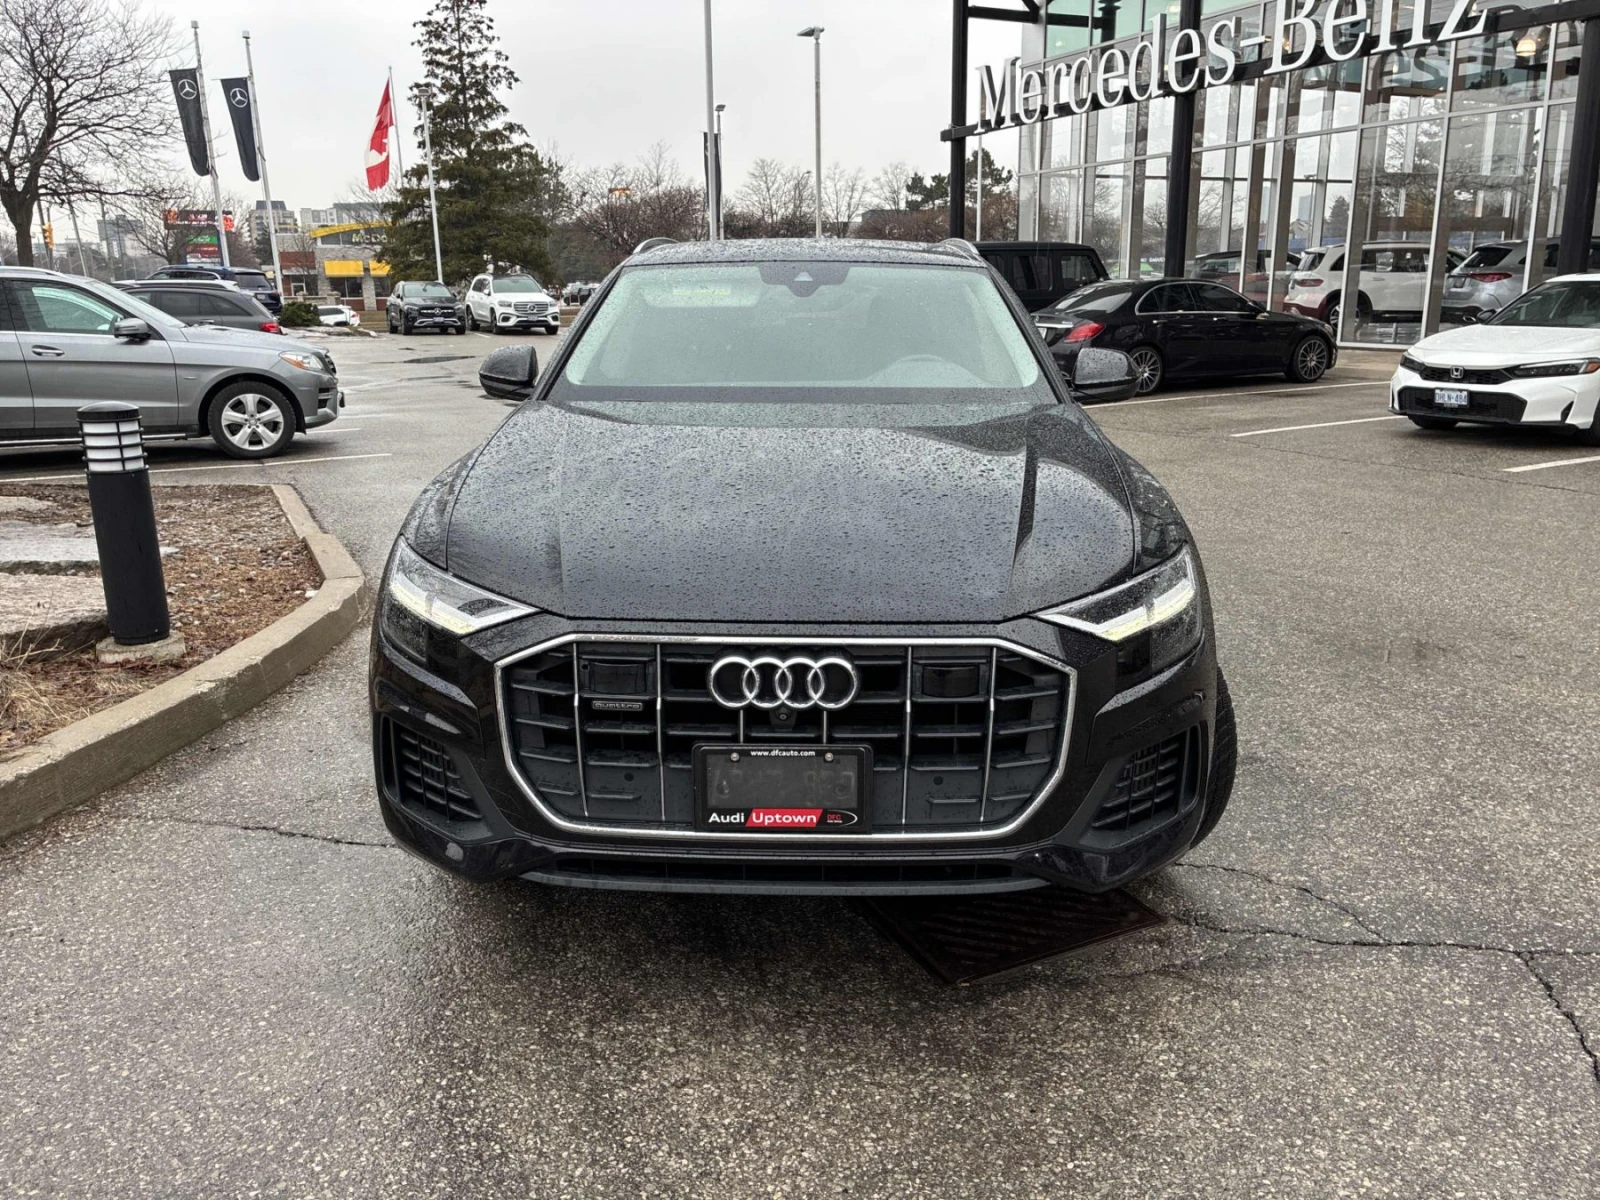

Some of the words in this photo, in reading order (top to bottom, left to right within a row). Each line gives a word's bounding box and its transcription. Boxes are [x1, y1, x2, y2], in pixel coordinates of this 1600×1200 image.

[750, 749, 816, 757] www.dfcauto.com
[708, 812, 745, 823] Audi
[752, 812, 817, 826] Uptown
